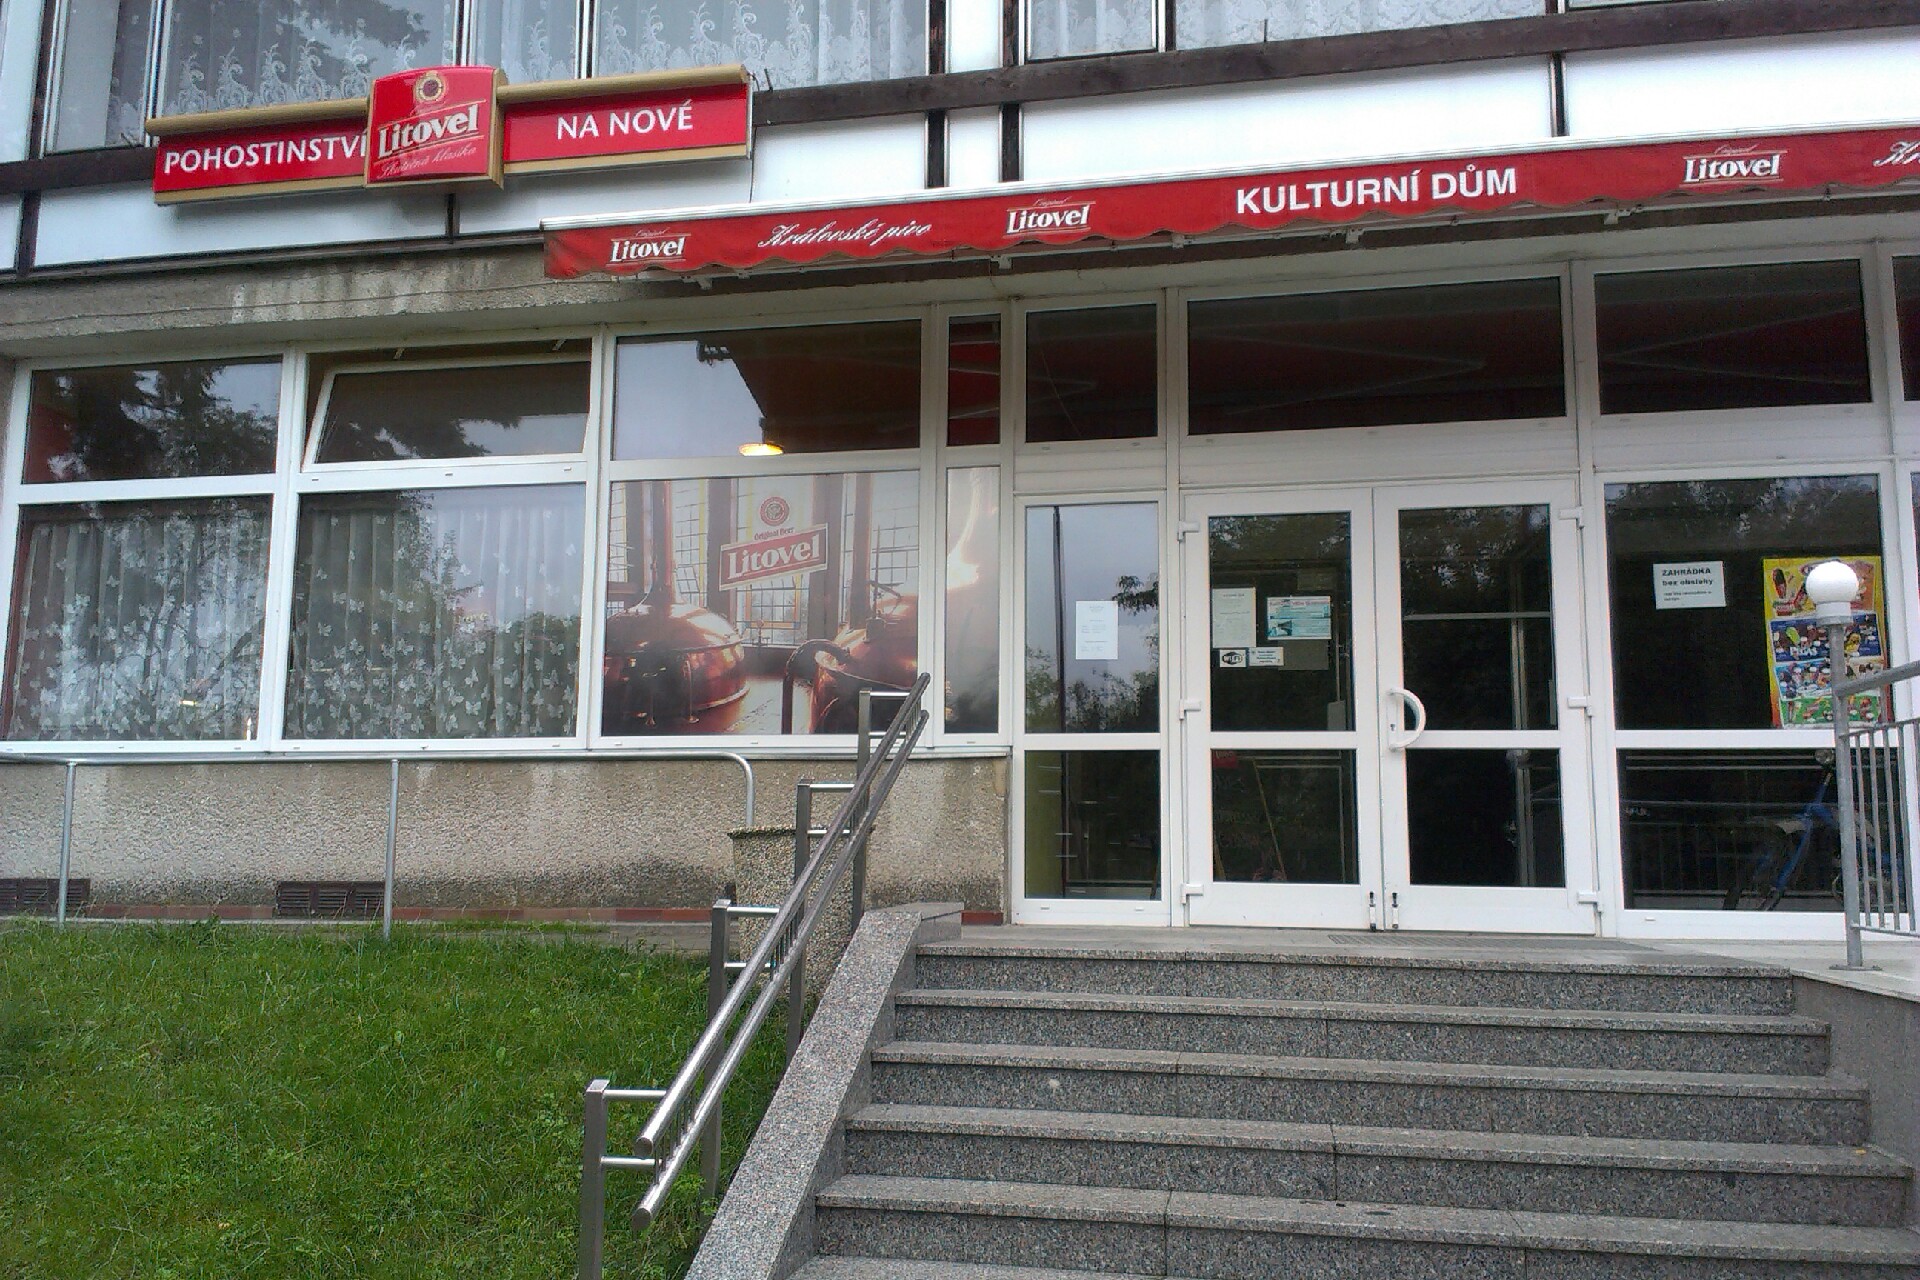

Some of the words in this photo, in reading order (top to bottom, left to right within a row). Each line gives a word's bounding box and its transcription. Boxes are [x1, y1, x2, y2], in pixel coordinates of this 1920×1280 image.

[378, 103, 480, 159] Litovel
[557, 114, 600, 140] NA
[609, 98, 694, 136] NOVÉ
[164, 128, 367, 174] POHOSTINSTVÍ
[1684, 153, 1781, 183] Litovel
[1237, 169, 1422, 214] KULTURNÍ
[1431, 164, 1517, 200] DŮM
[757, 218, 886, 248] Královské
[869, 220, 933, 247] pivo
[1006, 203, 1091, 234] Litovel
[610, 236, 686, 262] Litovel
[727, 533, 820, 580] Litovel
